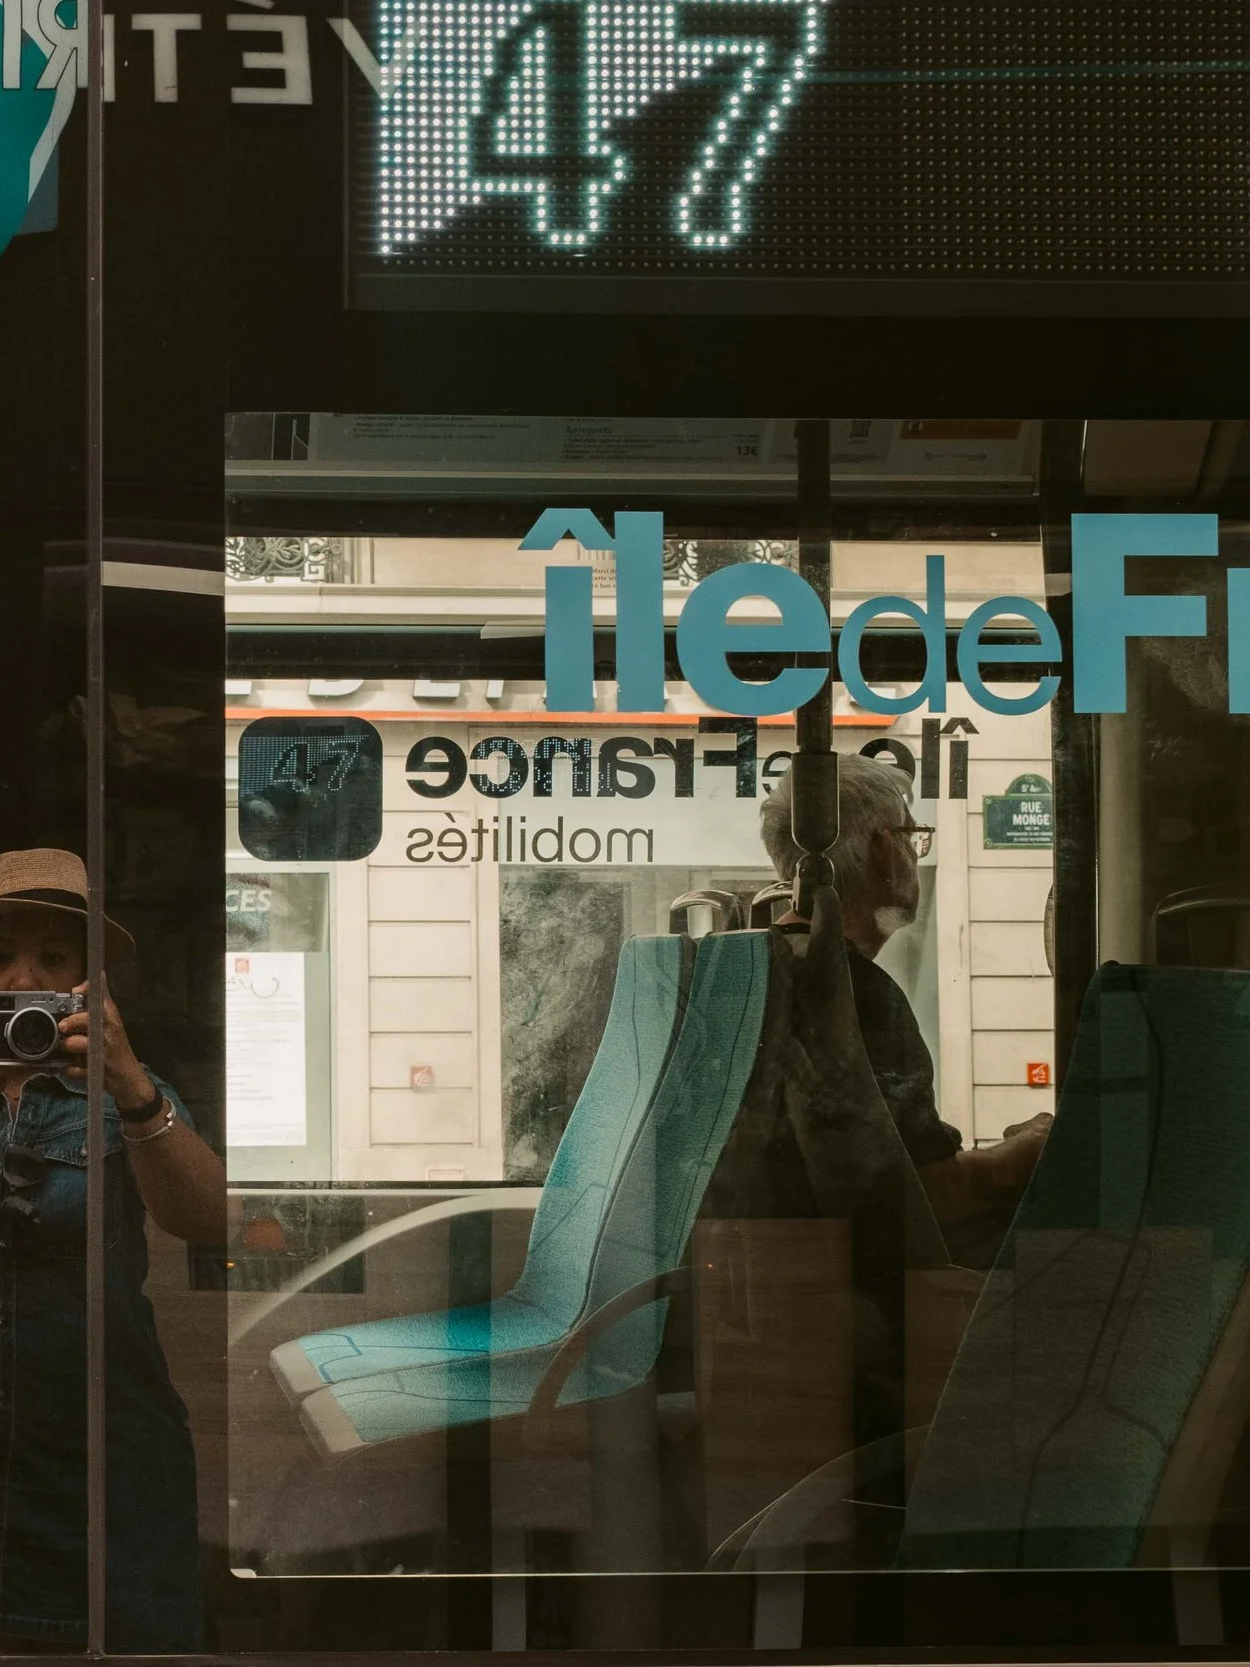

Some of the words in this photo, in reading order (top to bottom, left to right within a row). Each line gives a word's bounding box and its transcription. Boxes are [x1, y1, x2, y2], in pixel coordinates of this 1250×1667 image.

[460, 0, 822, 246] 47
[735, 445, 760, 457] 13€
[270, 740, 360, 793] 47
[1020, 801, 1043, 813] RUE
[1012, 814, 1051, 826] MONGE
